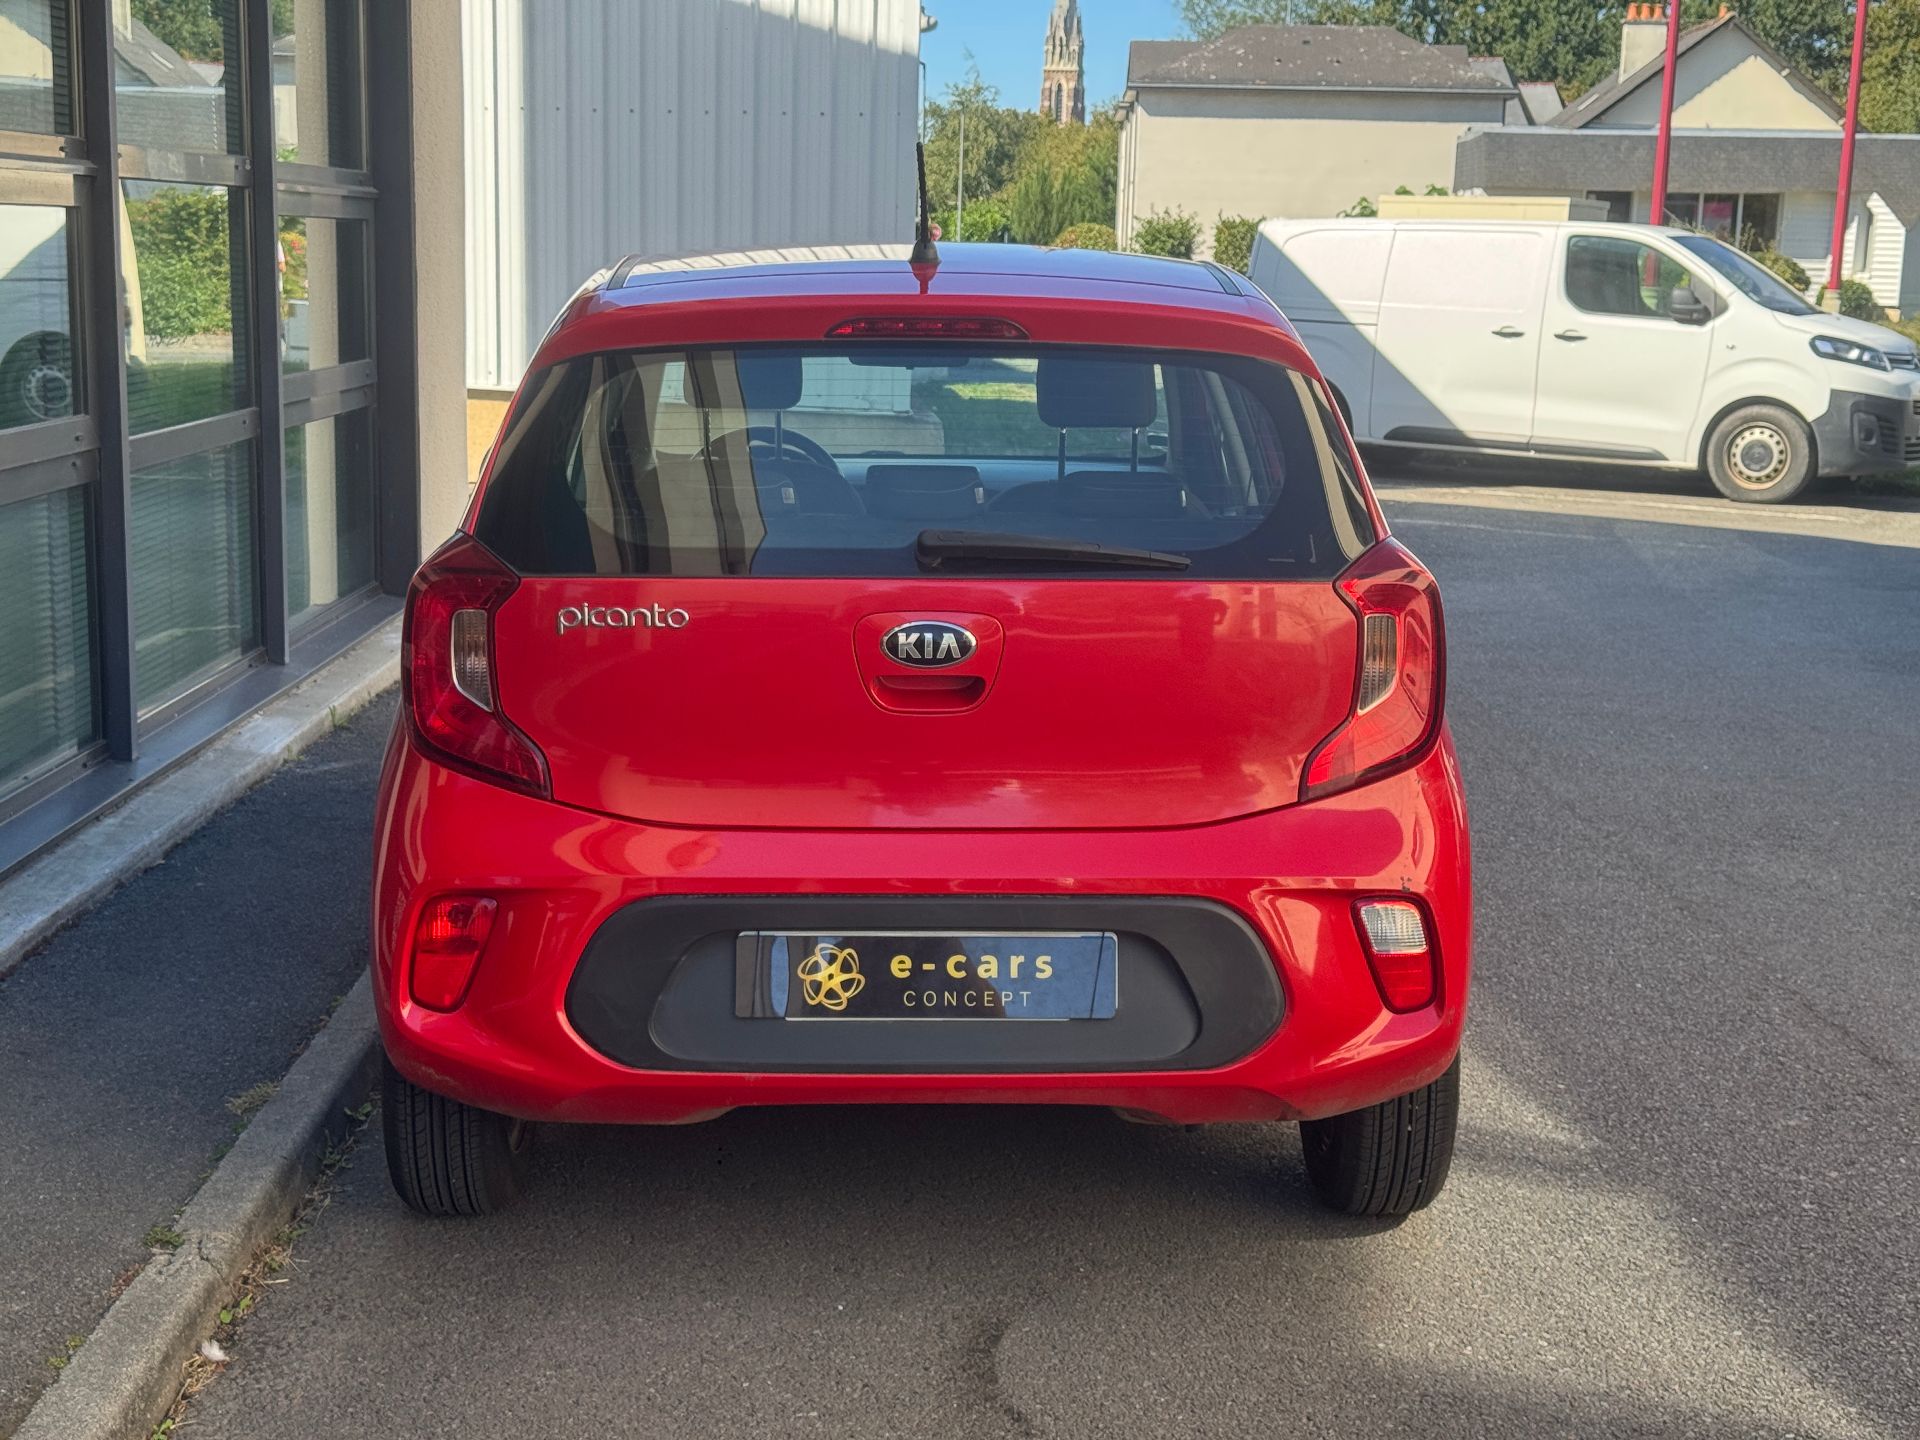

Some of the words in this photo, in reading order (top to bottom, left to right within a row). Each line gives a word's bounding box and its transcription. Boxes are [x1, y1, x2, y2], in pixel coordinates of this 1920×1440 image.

[557, 602, 690, 635] picanto
[898, 632, 962, 660] KIA
[889, 954, 1054, 979] e-cars
[903, 990, 1032, 1007] CONCEPT
